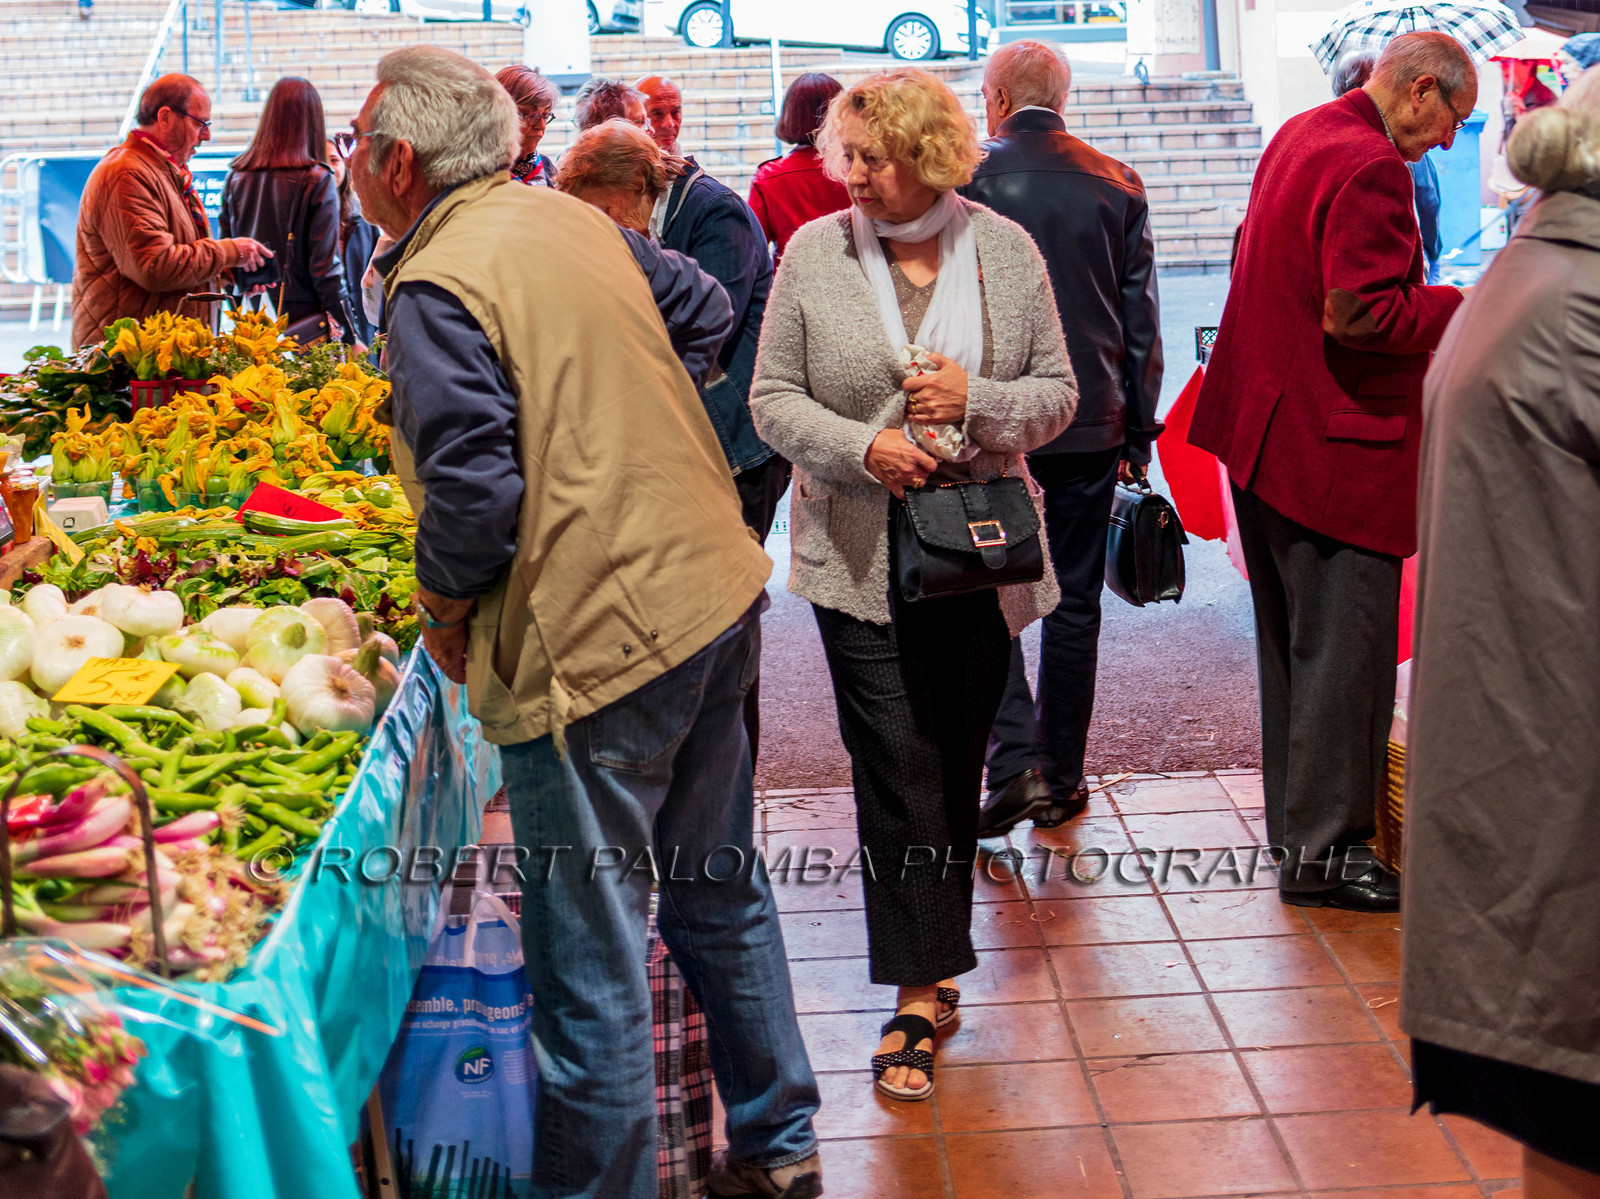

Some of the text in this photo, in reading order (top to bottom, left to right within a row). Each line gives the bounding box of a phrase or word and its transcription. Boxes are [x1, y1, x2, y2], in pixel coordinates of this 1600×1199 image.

[93, 658, 145, 668] PAYS
[76, 668, 138, 697] 5
[463, 1057, 492, 1076] NF
